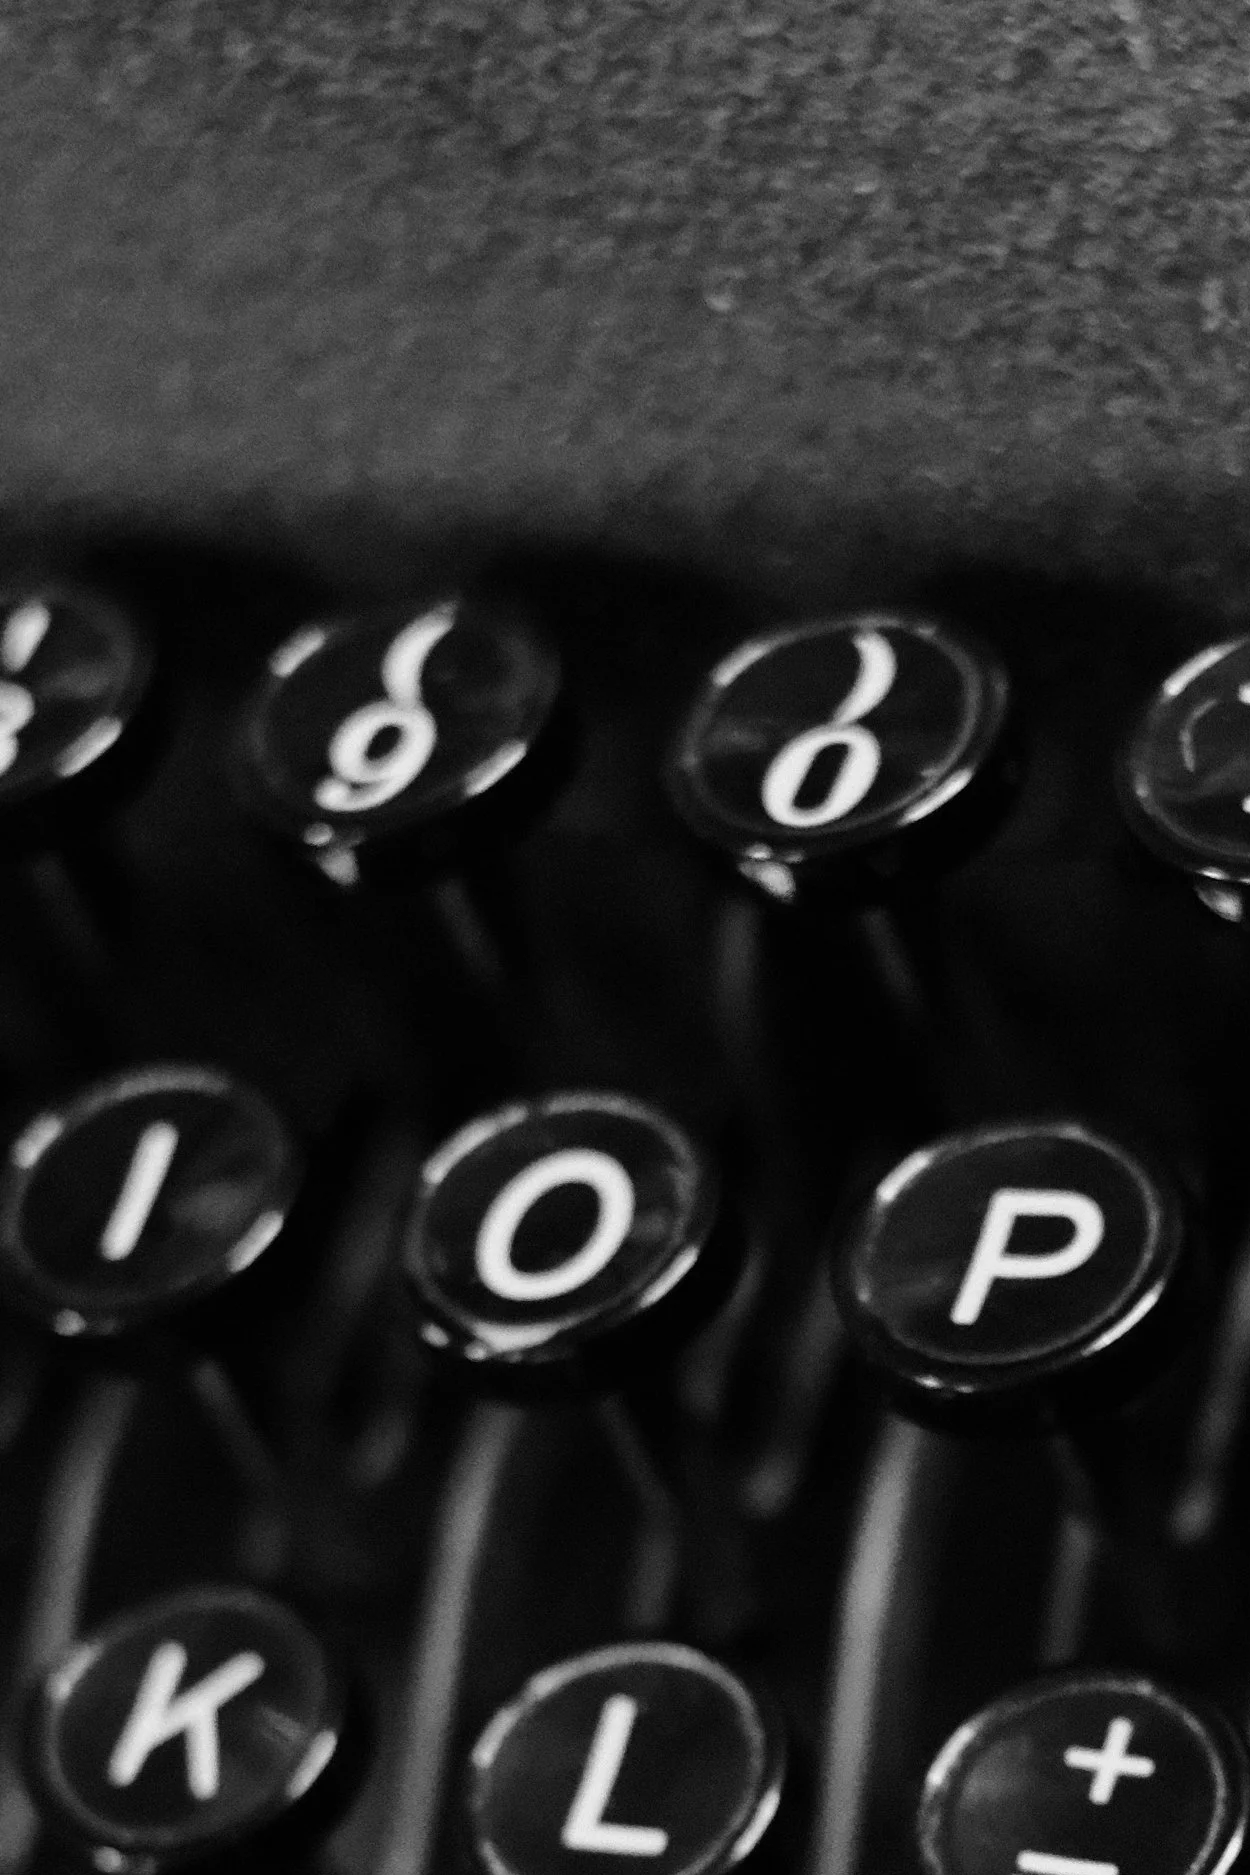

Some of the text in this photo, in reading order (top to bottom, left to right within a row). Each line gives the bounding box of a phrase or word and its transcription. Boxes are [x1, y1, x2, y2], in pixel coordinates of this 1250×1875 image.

[316, 697, 436, 811] 9
[104, 1125, 176, 1259] I
[475, 1140, 634, 1300] O
[951, 1189, 1103, 1324] P
[111, 1644, 262, 1798] K
[562, 1696, 667, 1855] L
[1065, 1718, 1154, 1804] +
